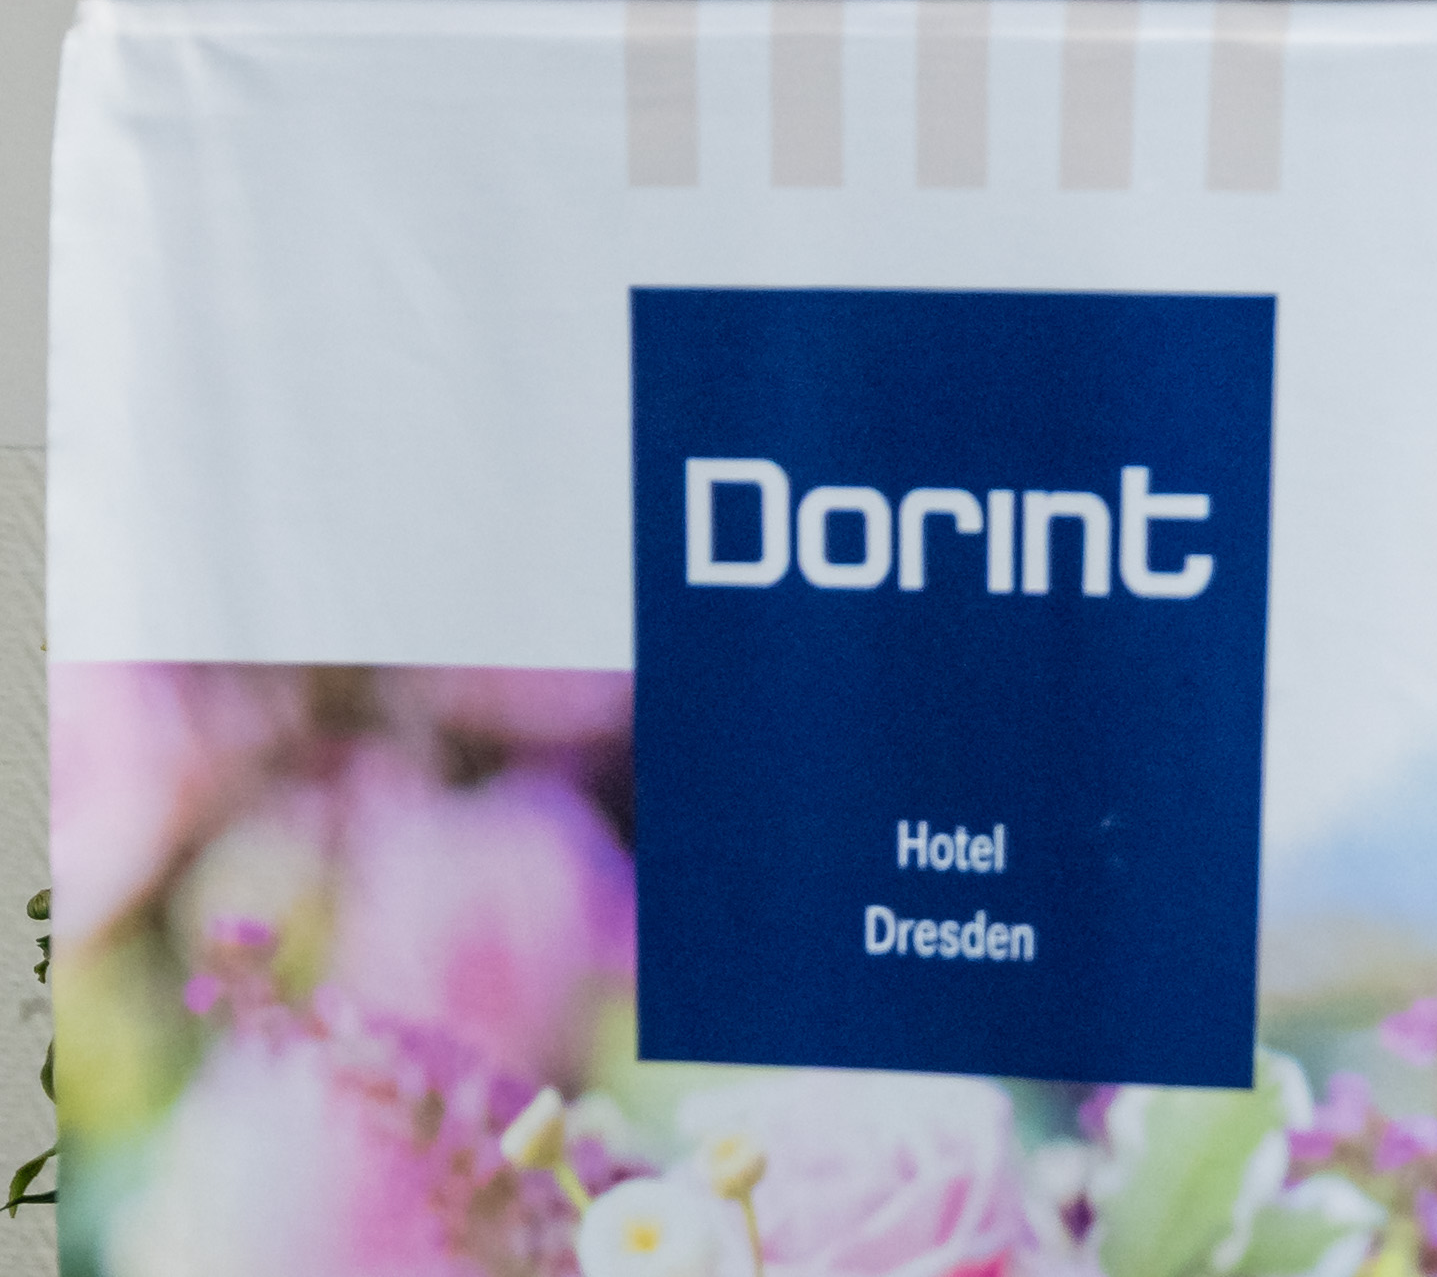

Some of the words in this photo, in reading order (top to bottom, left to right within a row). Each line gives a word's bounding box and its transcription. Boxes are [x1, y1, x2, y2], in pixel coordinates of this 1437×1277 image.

[682, 455, 1216, 600] Dorint
[895, 818, 1007, 874] Hotel
[863, 903, 1037, 963] Dresden
